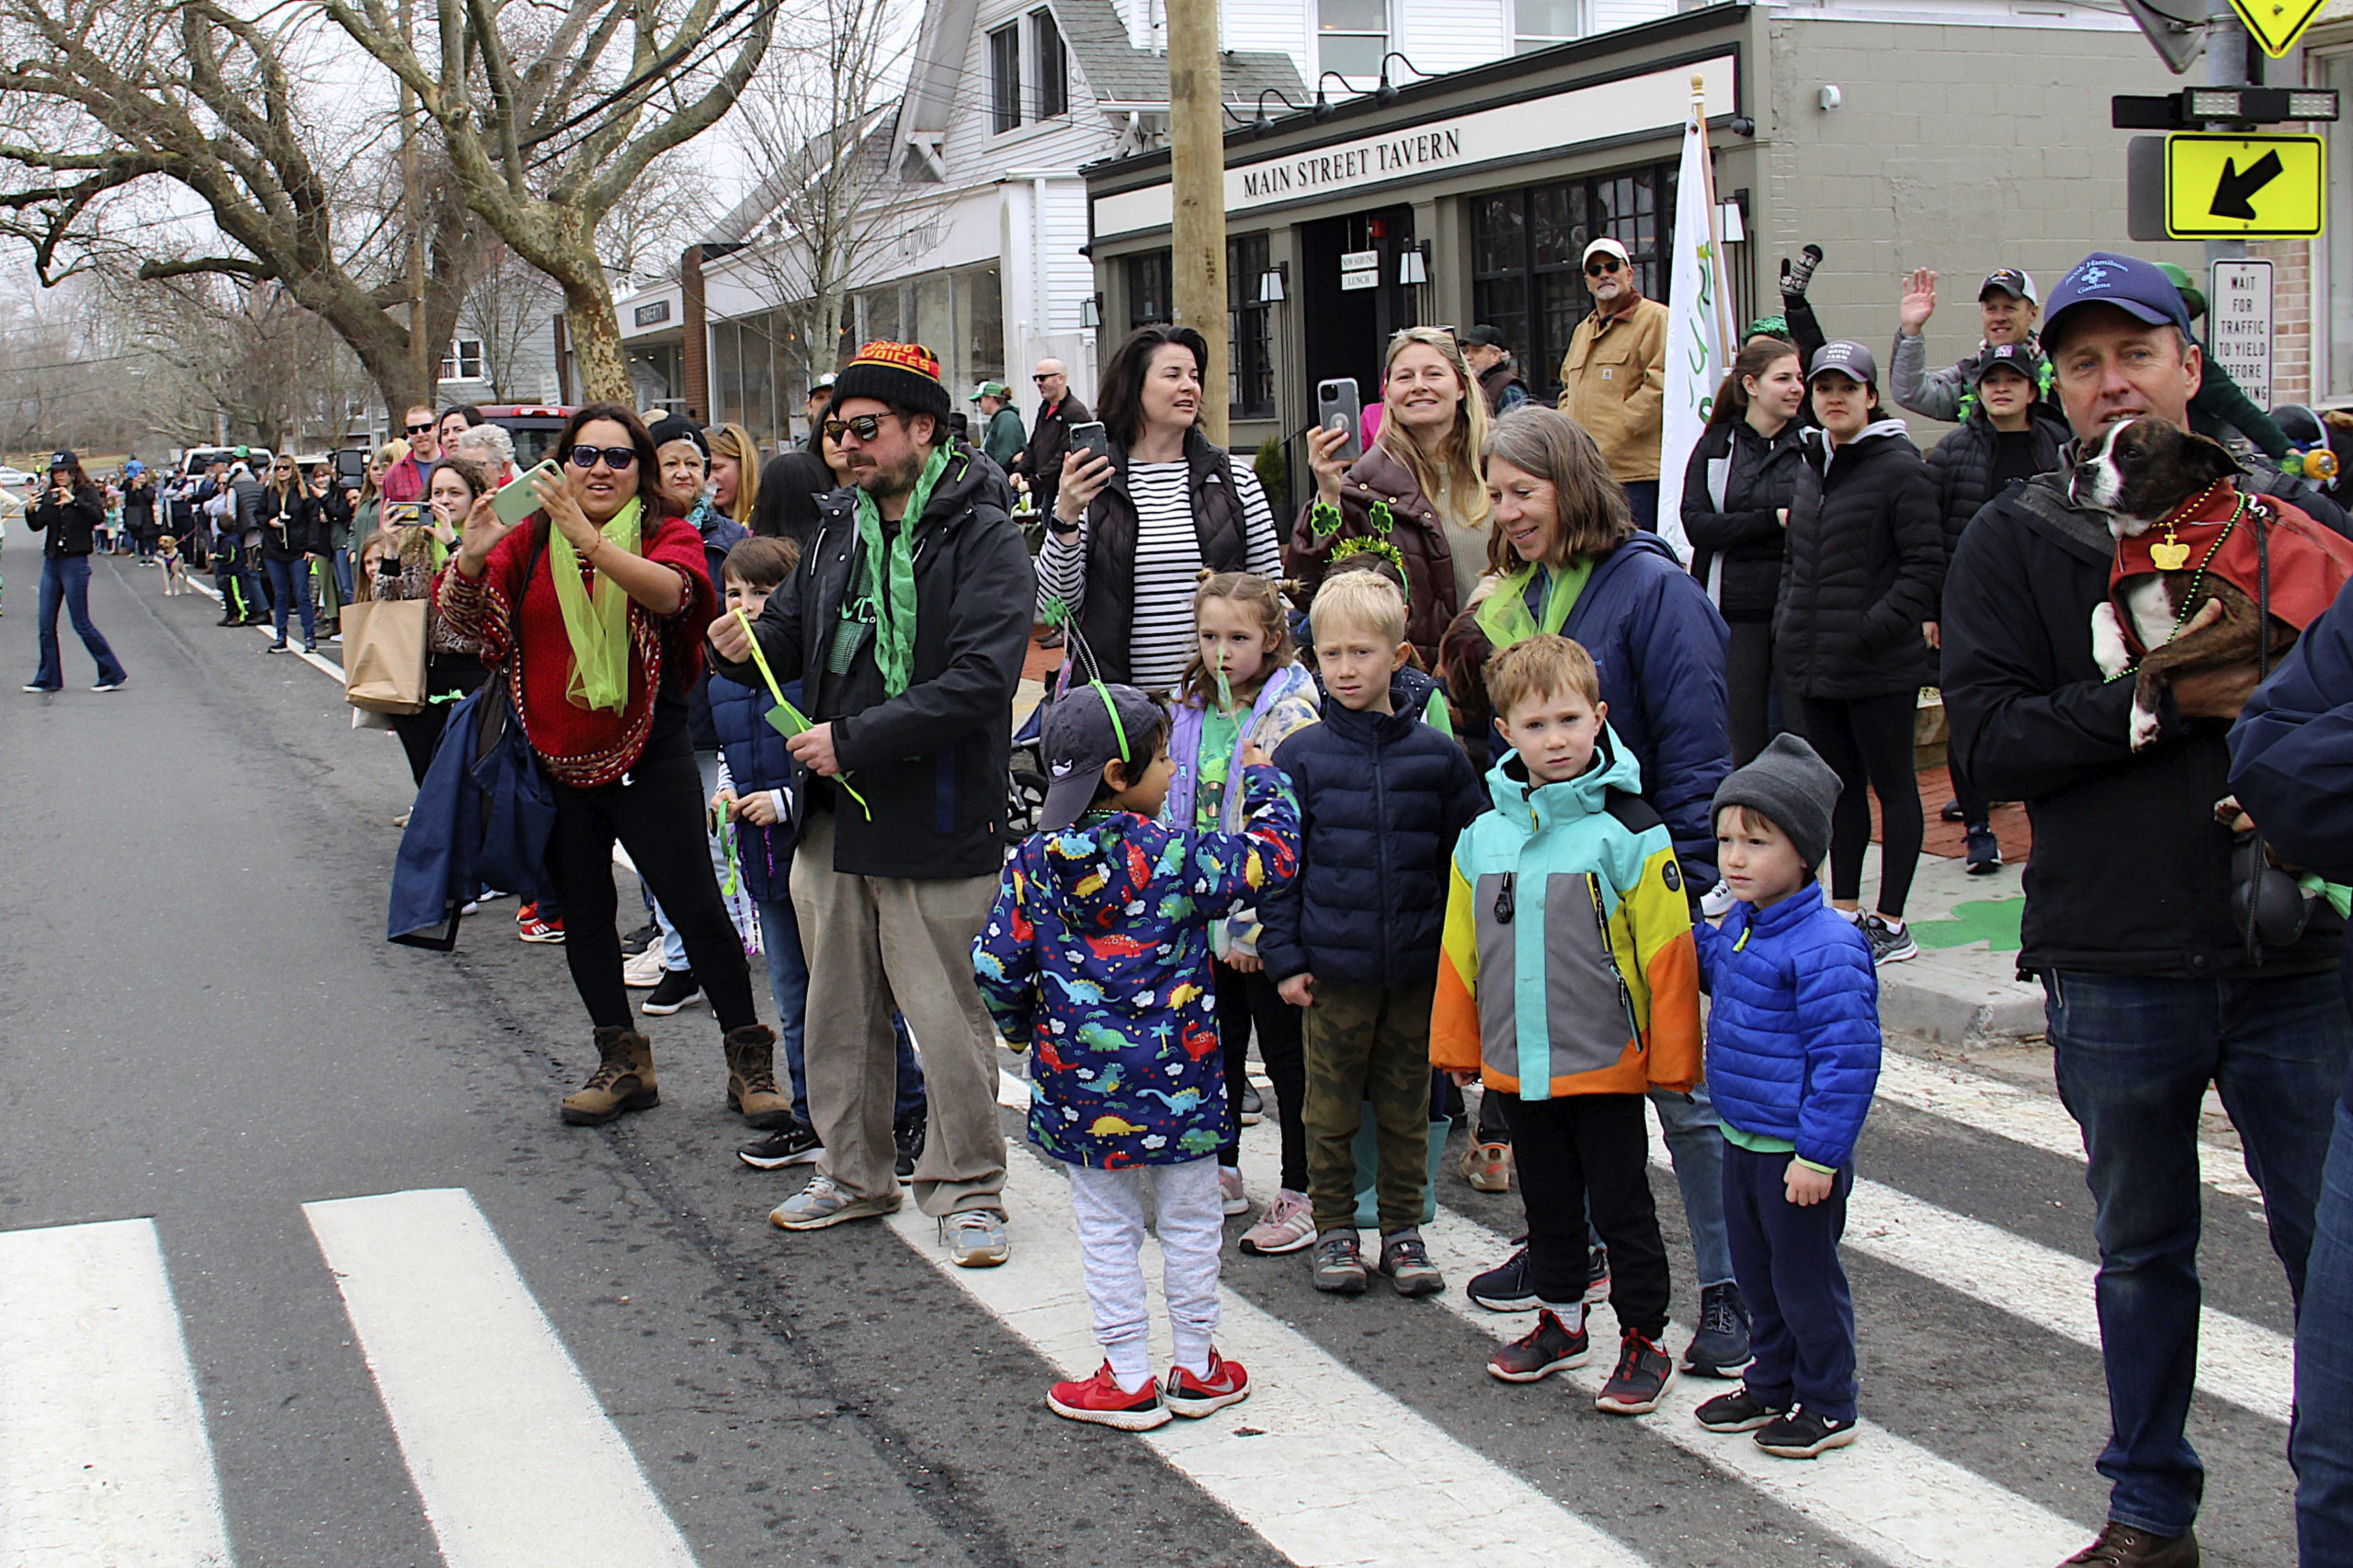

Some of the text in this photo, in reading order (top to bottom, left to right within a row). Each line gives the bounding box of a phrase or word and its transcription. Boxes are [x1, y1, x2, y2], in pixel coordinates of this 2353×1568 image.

[1244, 128, 1461, 199] MAIN STREET TAVERN
[1347, 275, 1370, 286] LUNCH
[2231, 277, 2256, 290] WAIT
[2077, 283, 2111, 295] Gardens
[2233, 299, 2253, 312] FOR
[2222, 321, 2264, 335] TRAFFIC
[1827, 348, 1851, 357] WAVES
[2219, 343, 2265, 357] TO YIELD
[860, 349, 930, 371] VOICES
